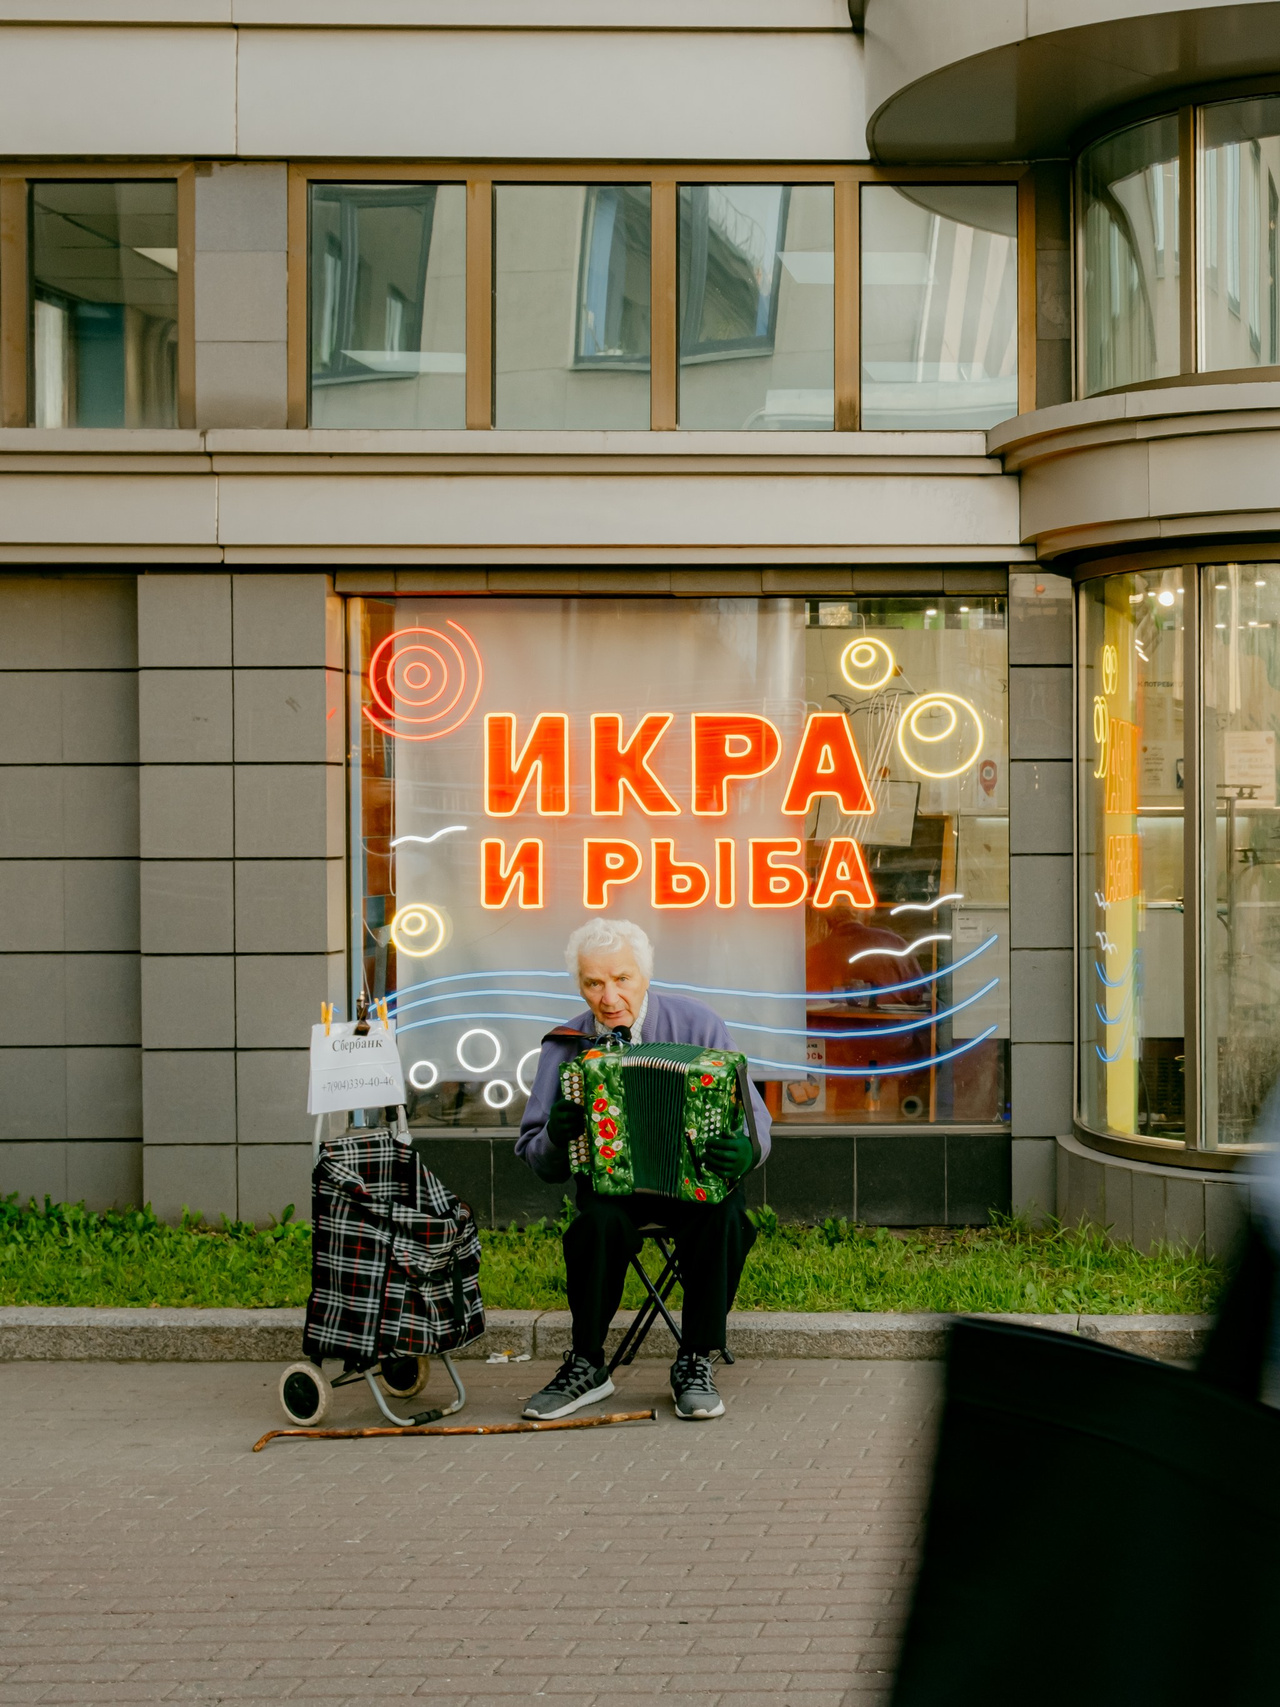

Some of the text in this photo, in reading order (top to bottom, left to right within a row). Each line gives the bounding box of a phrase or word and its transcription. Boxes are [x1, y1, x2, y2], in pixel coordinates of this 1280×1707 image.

[483, 712, 876, 817] ИКРА
[480, 837, 877, 910] И РЫБА
[332, 1038, 383, 1053] Сбербанк
[321, 1075, 394, 1093] +7(904)339-40-46
